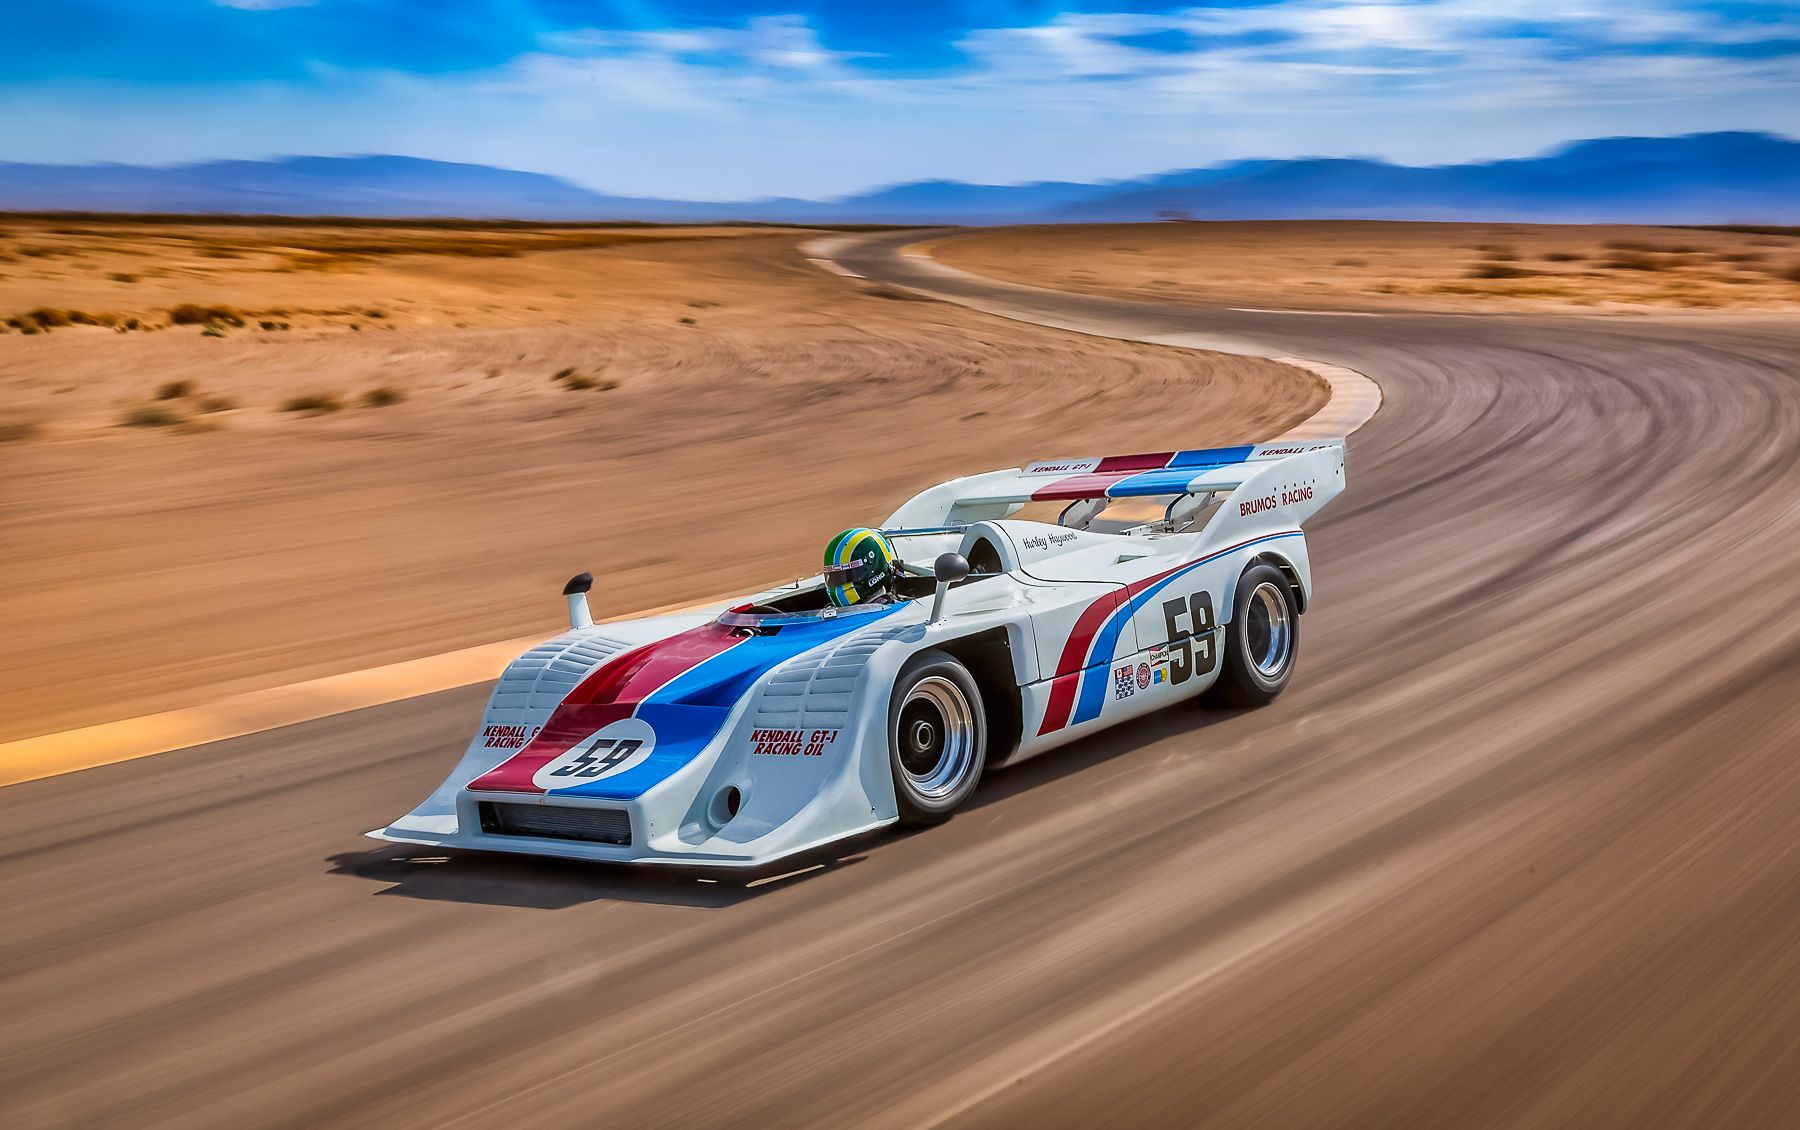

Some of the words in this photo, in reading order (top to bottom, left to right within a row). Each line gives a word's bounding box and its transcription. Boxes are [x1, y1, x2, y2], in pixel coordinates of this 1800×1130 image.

[1258, 446, 1305, 456] KENDALL
[1031, 465, 1070, 473] KENDALL
[1240, 495, 1277, 516] BRUMOS
[1281, 486, 1313, 506] RACING
[1022, 536, 1048, 550] Hurley
[1162, 590, 1217, 686] 59
[483, 725, 527, 737] KENDALL
[750, 729, 805, 742] KENDALL
[810, 730, 838, 743] GT-1
[484, 737, 525, 748] RACING
[753, 743, 802, 755] RACING
[803, 743, 824, 756] OIL
[549, 738, 644, 777] 59
